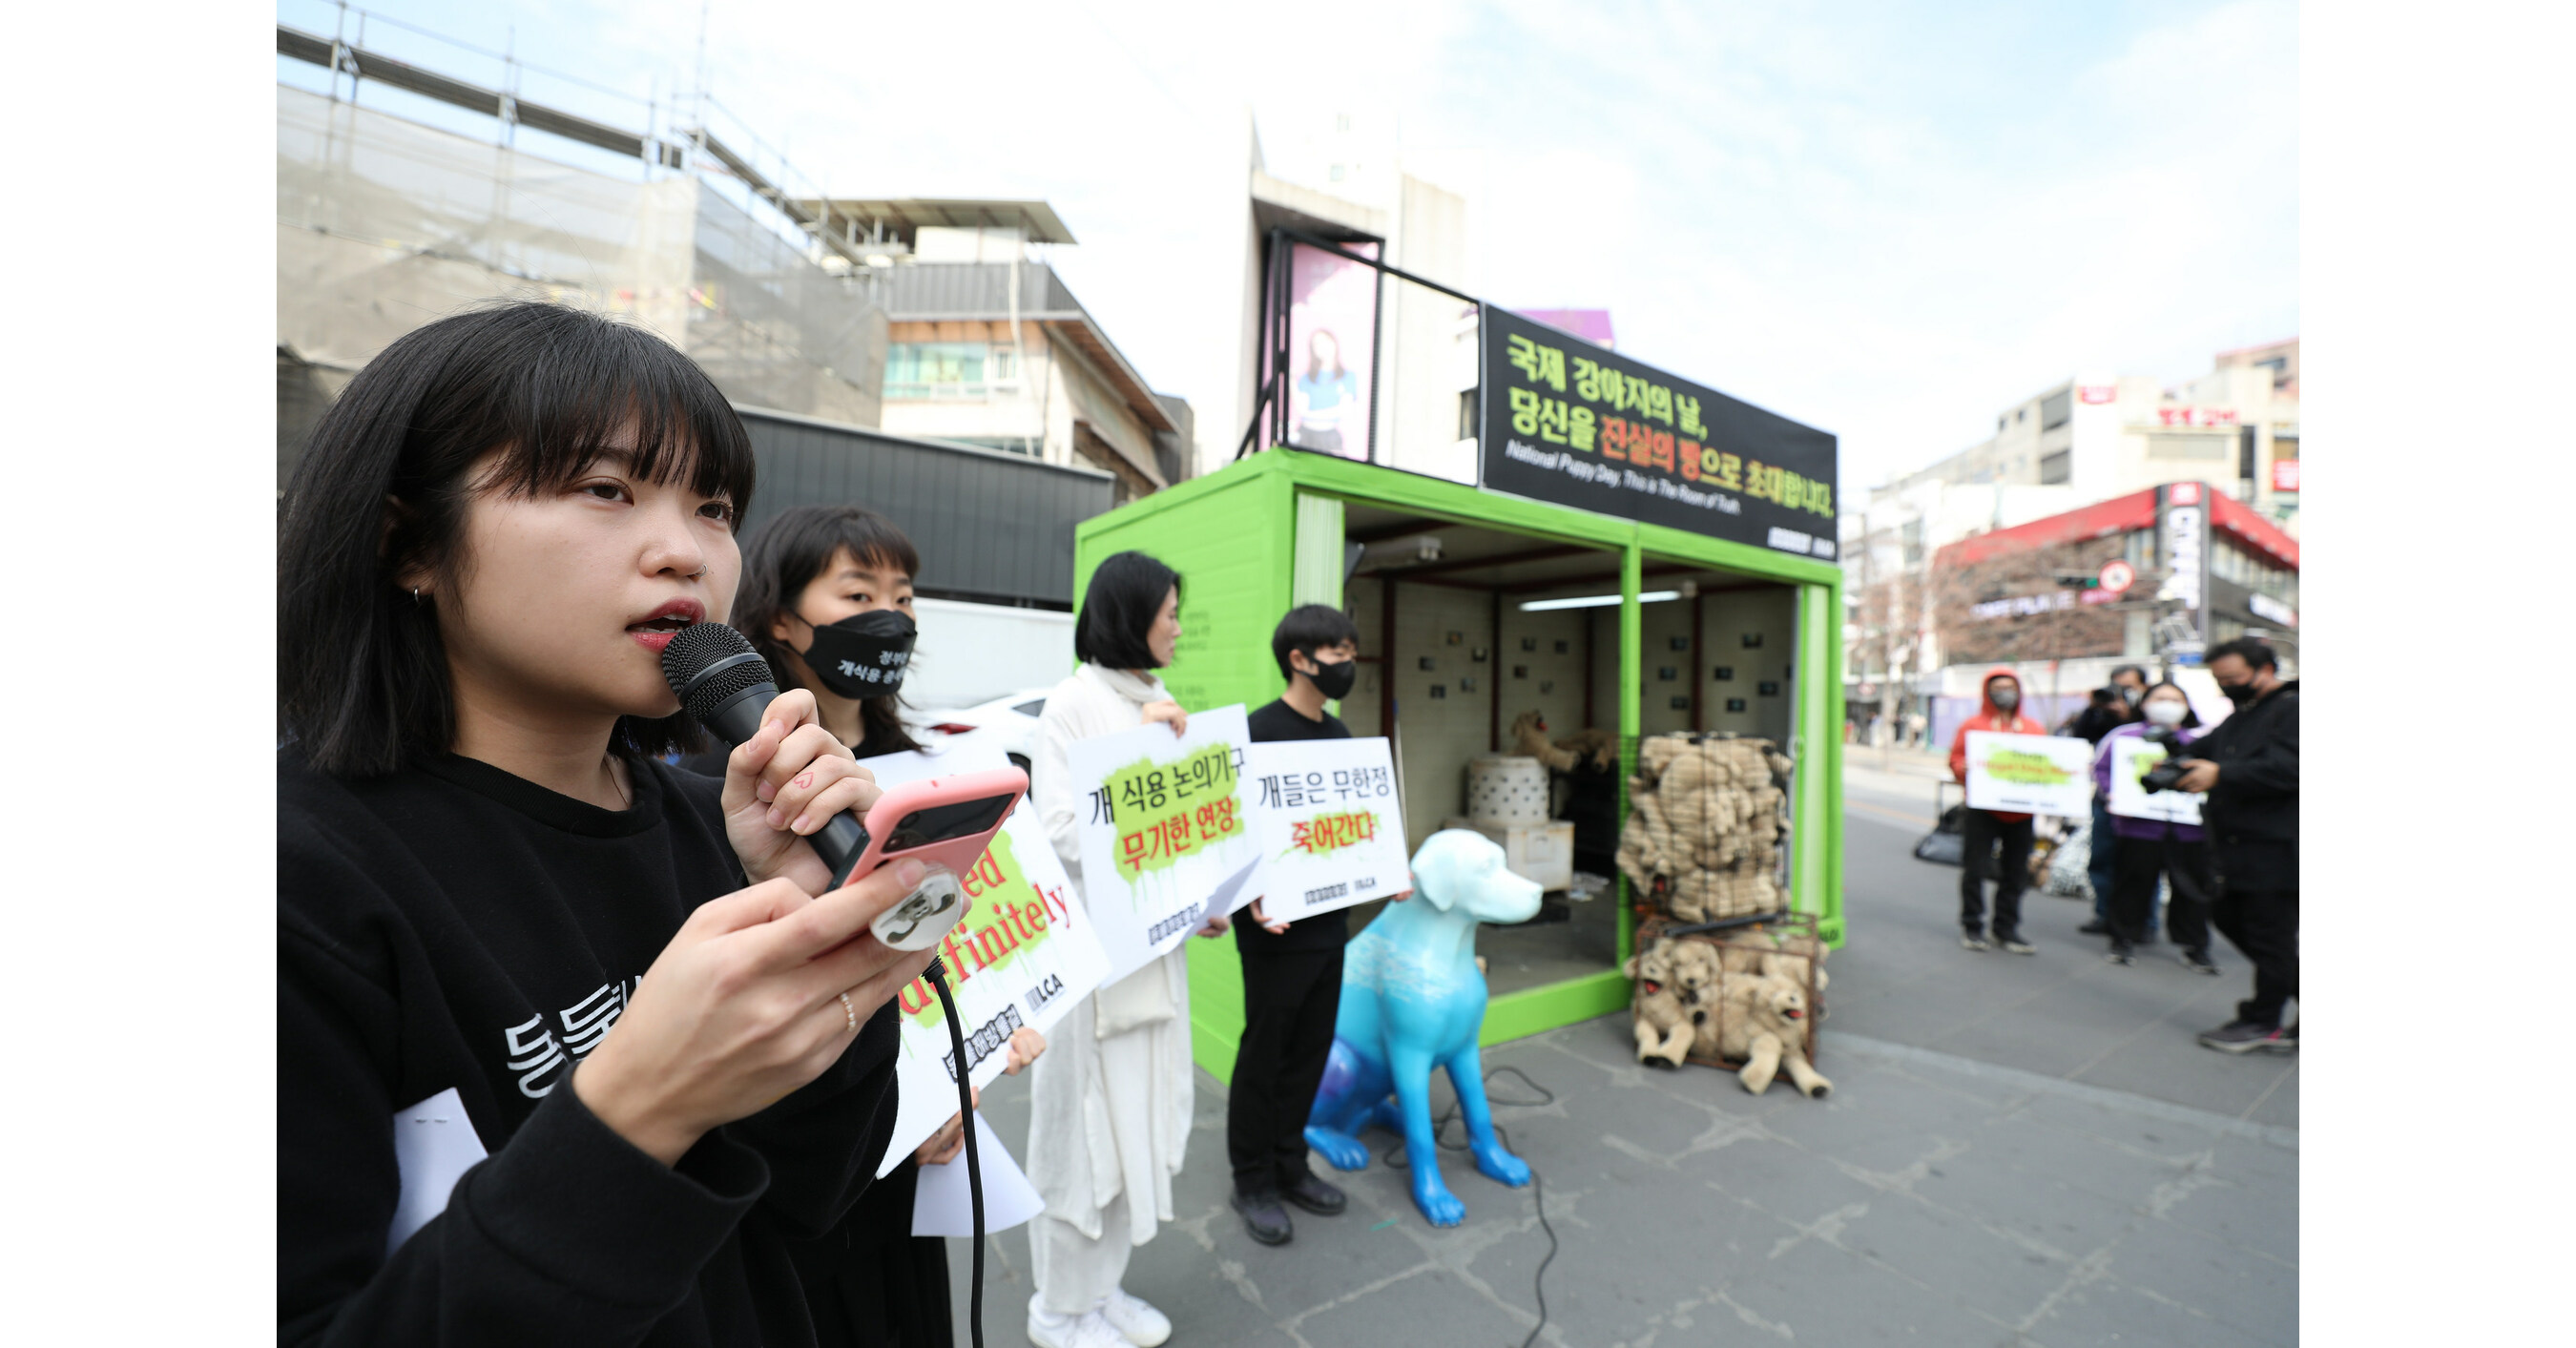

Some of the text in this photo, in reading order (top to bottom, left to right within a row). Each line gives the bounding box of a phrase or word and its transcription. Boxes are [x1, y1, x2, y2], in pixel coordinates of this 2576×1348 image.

[1506, 333, 1708, 443] 국제 강아지의 날,
[1505, 438, 1559, 470] National
[1508, 385, 1835, 519] 당신을 진실의 방으로 초대합니다.
[1089, 747, 1246, 826] 개 식용 논의기구
[1257, 766, 1391, 809] 개들은 무한정
[1122, 796, 1235, 872] 무기한 연장
[1291, 810, 1376, 855] 죽어간다
